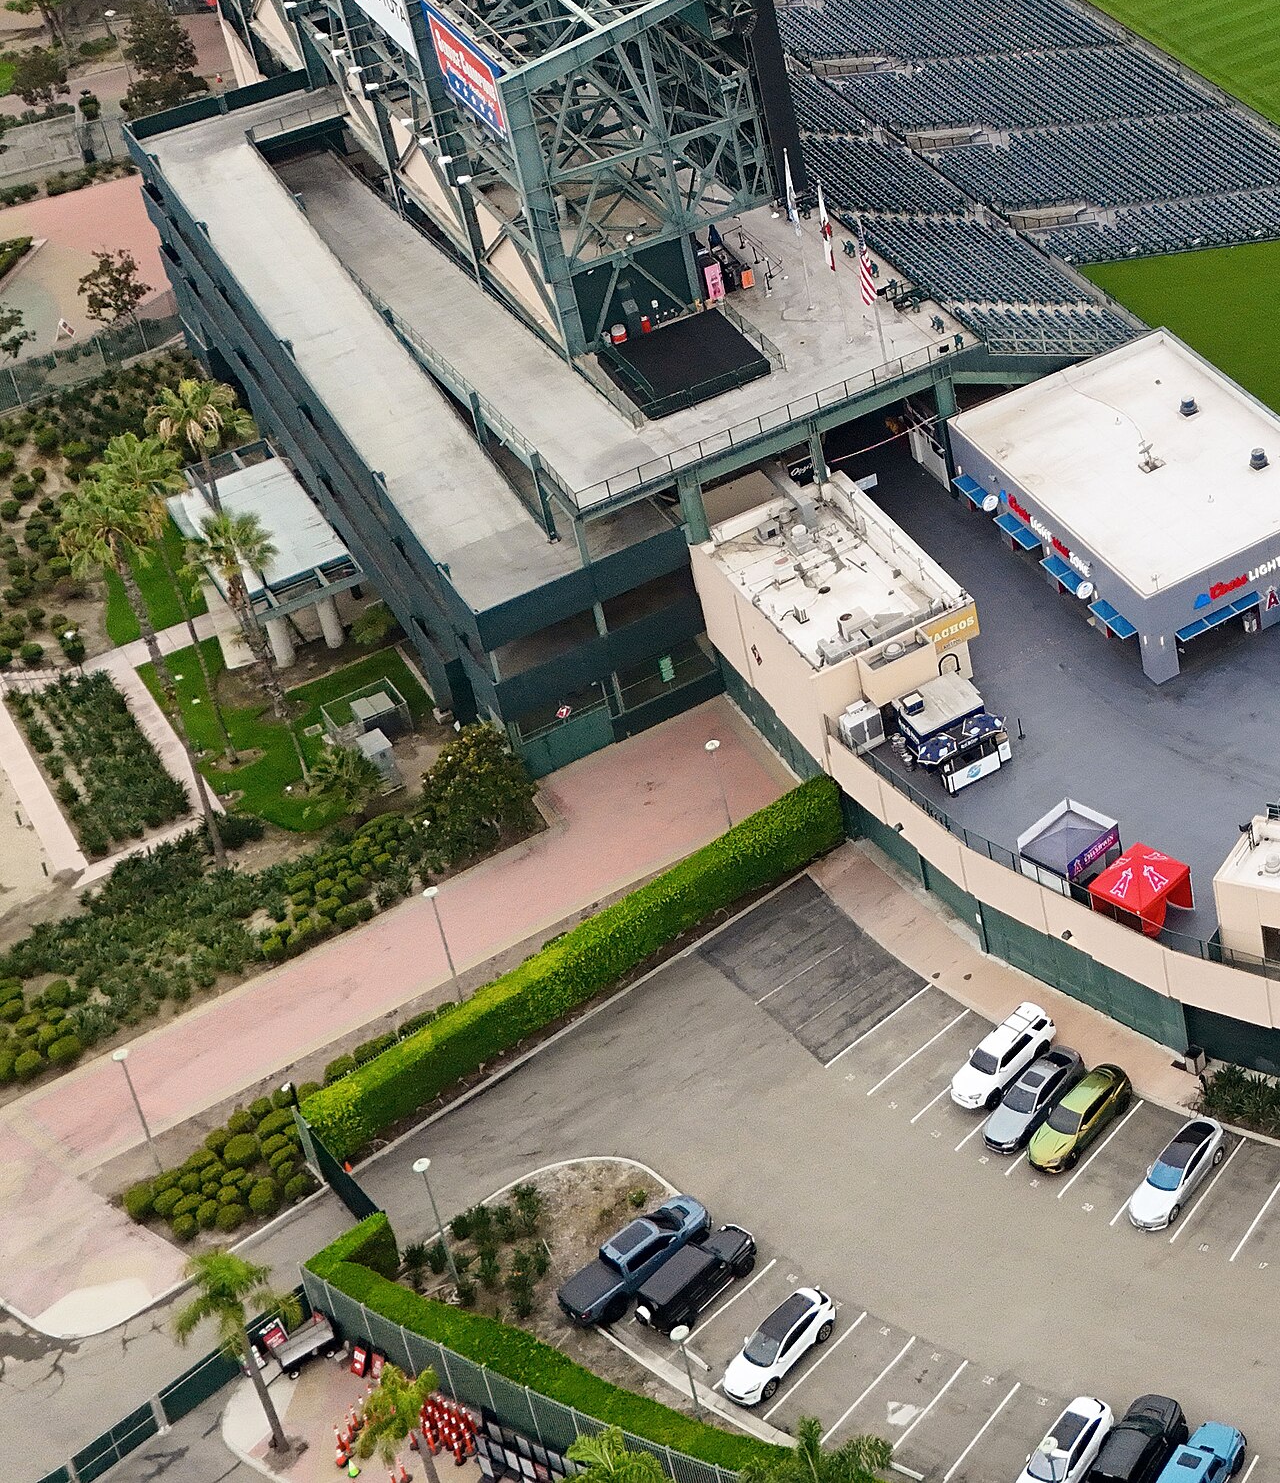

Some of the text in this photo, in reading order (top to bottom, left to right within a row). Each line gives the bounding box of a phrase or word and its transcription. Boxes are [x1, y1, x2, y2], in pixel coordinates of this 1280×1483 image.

[1030, 516, 1053, 542] LIGHT
[1069, 551, 1091, 578] ZONE
[1209, 574, 1248, 600] Coors
[1081, 1202, 1094, 1212] 20
